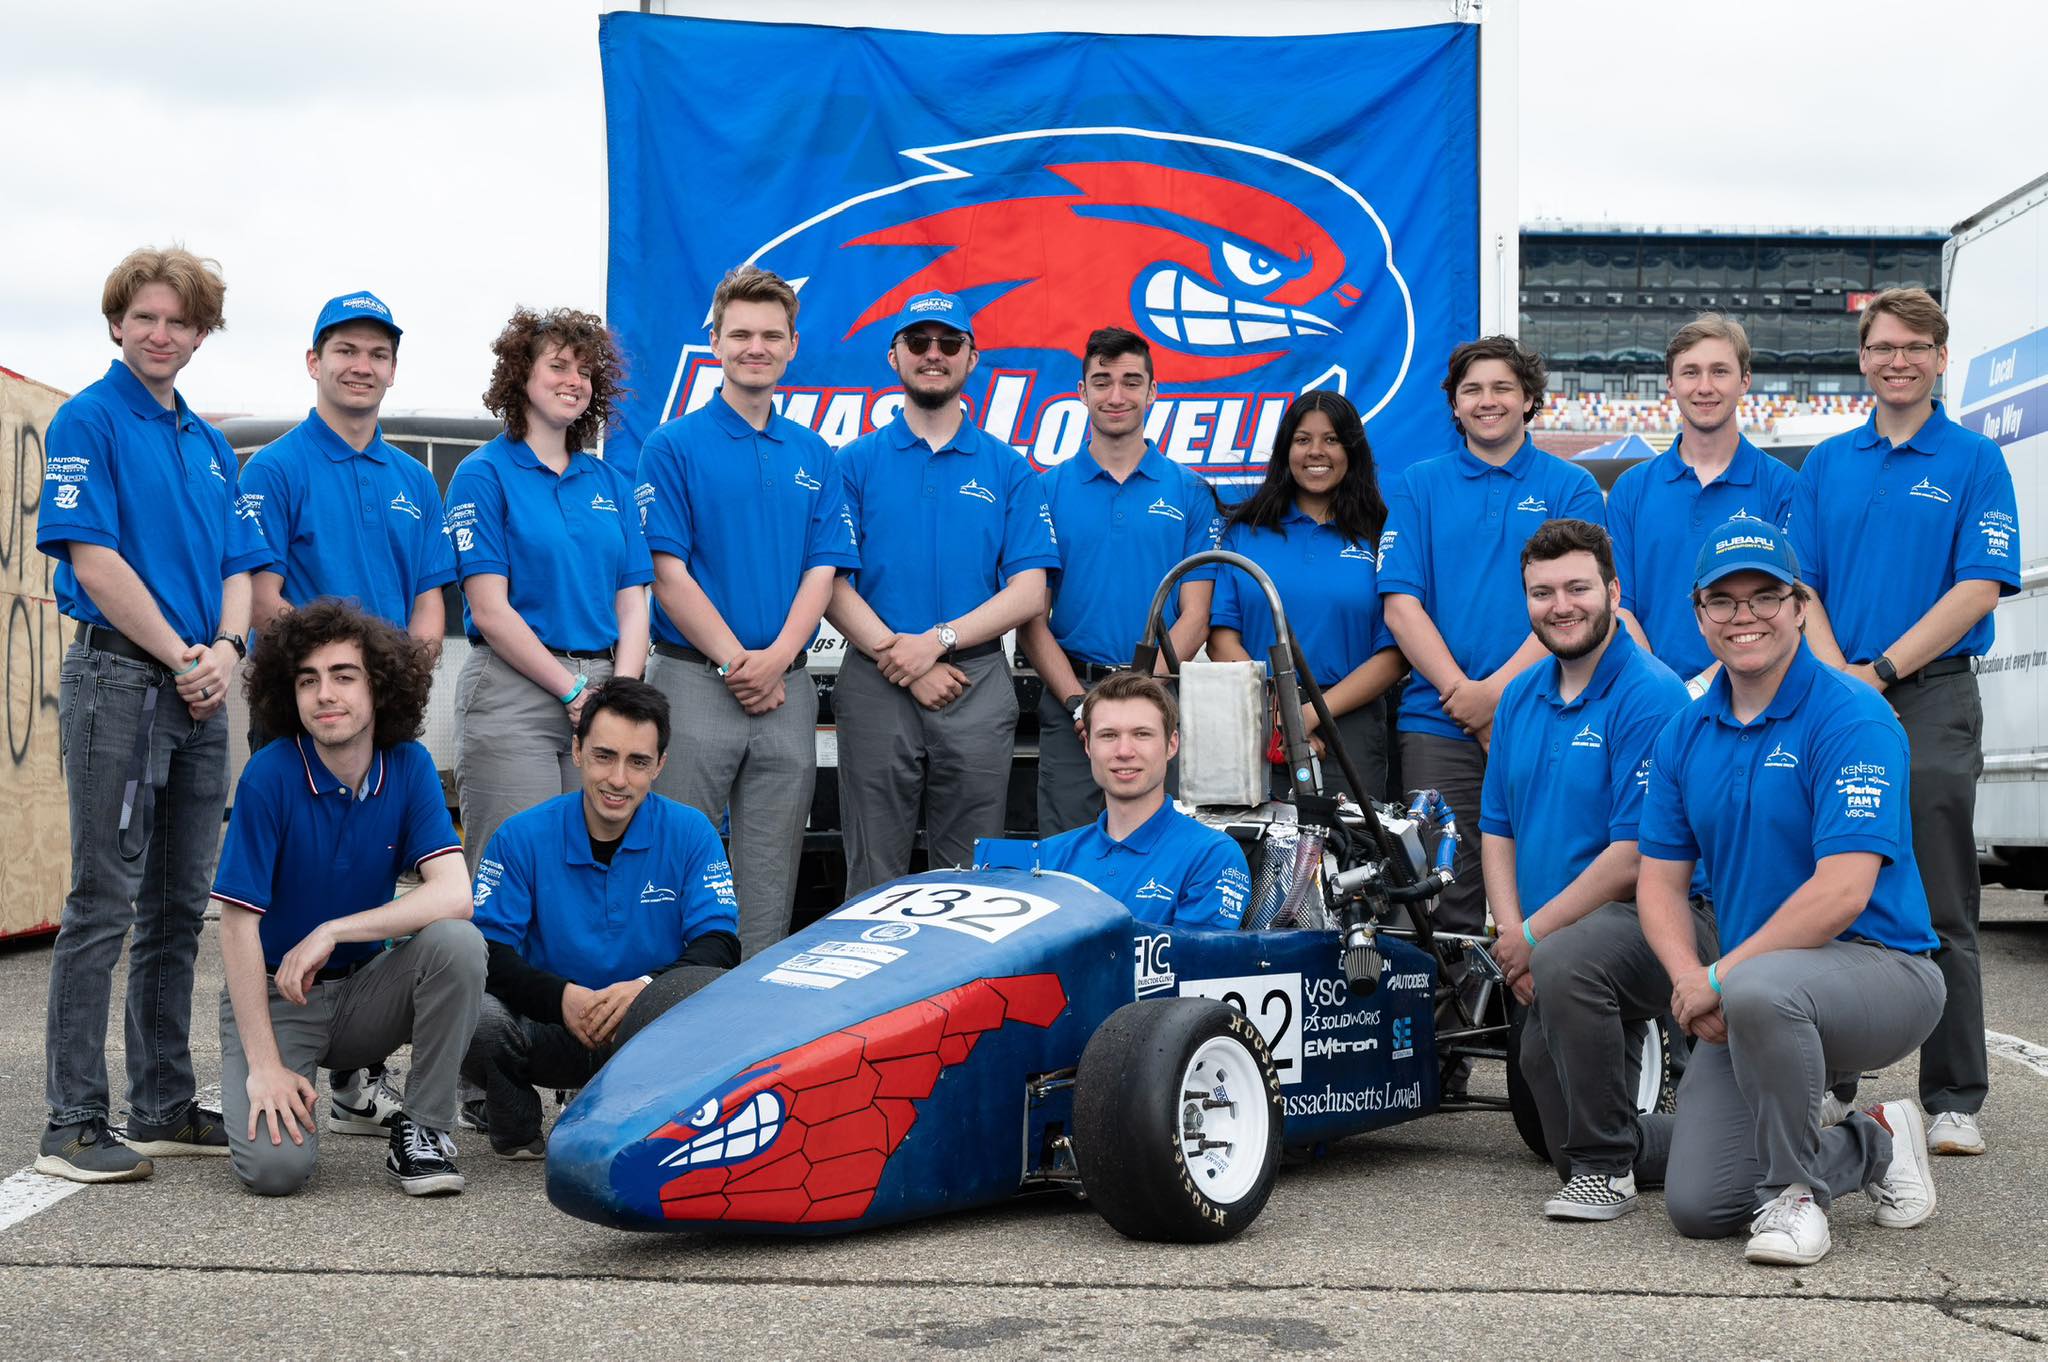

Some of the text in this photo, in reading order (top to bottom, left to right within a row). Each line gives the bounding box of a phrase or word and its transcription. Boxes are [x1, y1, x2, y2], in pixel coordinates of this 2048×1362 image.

[1988, 348, 2017, 388] Local
[1983, 402, 2024, 440] One Way
[1715, 535, 1775, 551] SUBARU
[1846, 784, 1882, 796] Parker
[868, 887, 1032, 934] 132
[1304, 978, 1348, 1007] VSC
[1394, 973, 1430, 990] AUTODESK
[1320, 1009, 1381, 1030] SOLIDWORKS
[1303, 1036, 1379, 1060] EMtron
[1282, 1080, 1422, 1116] assachusetts Lowell
